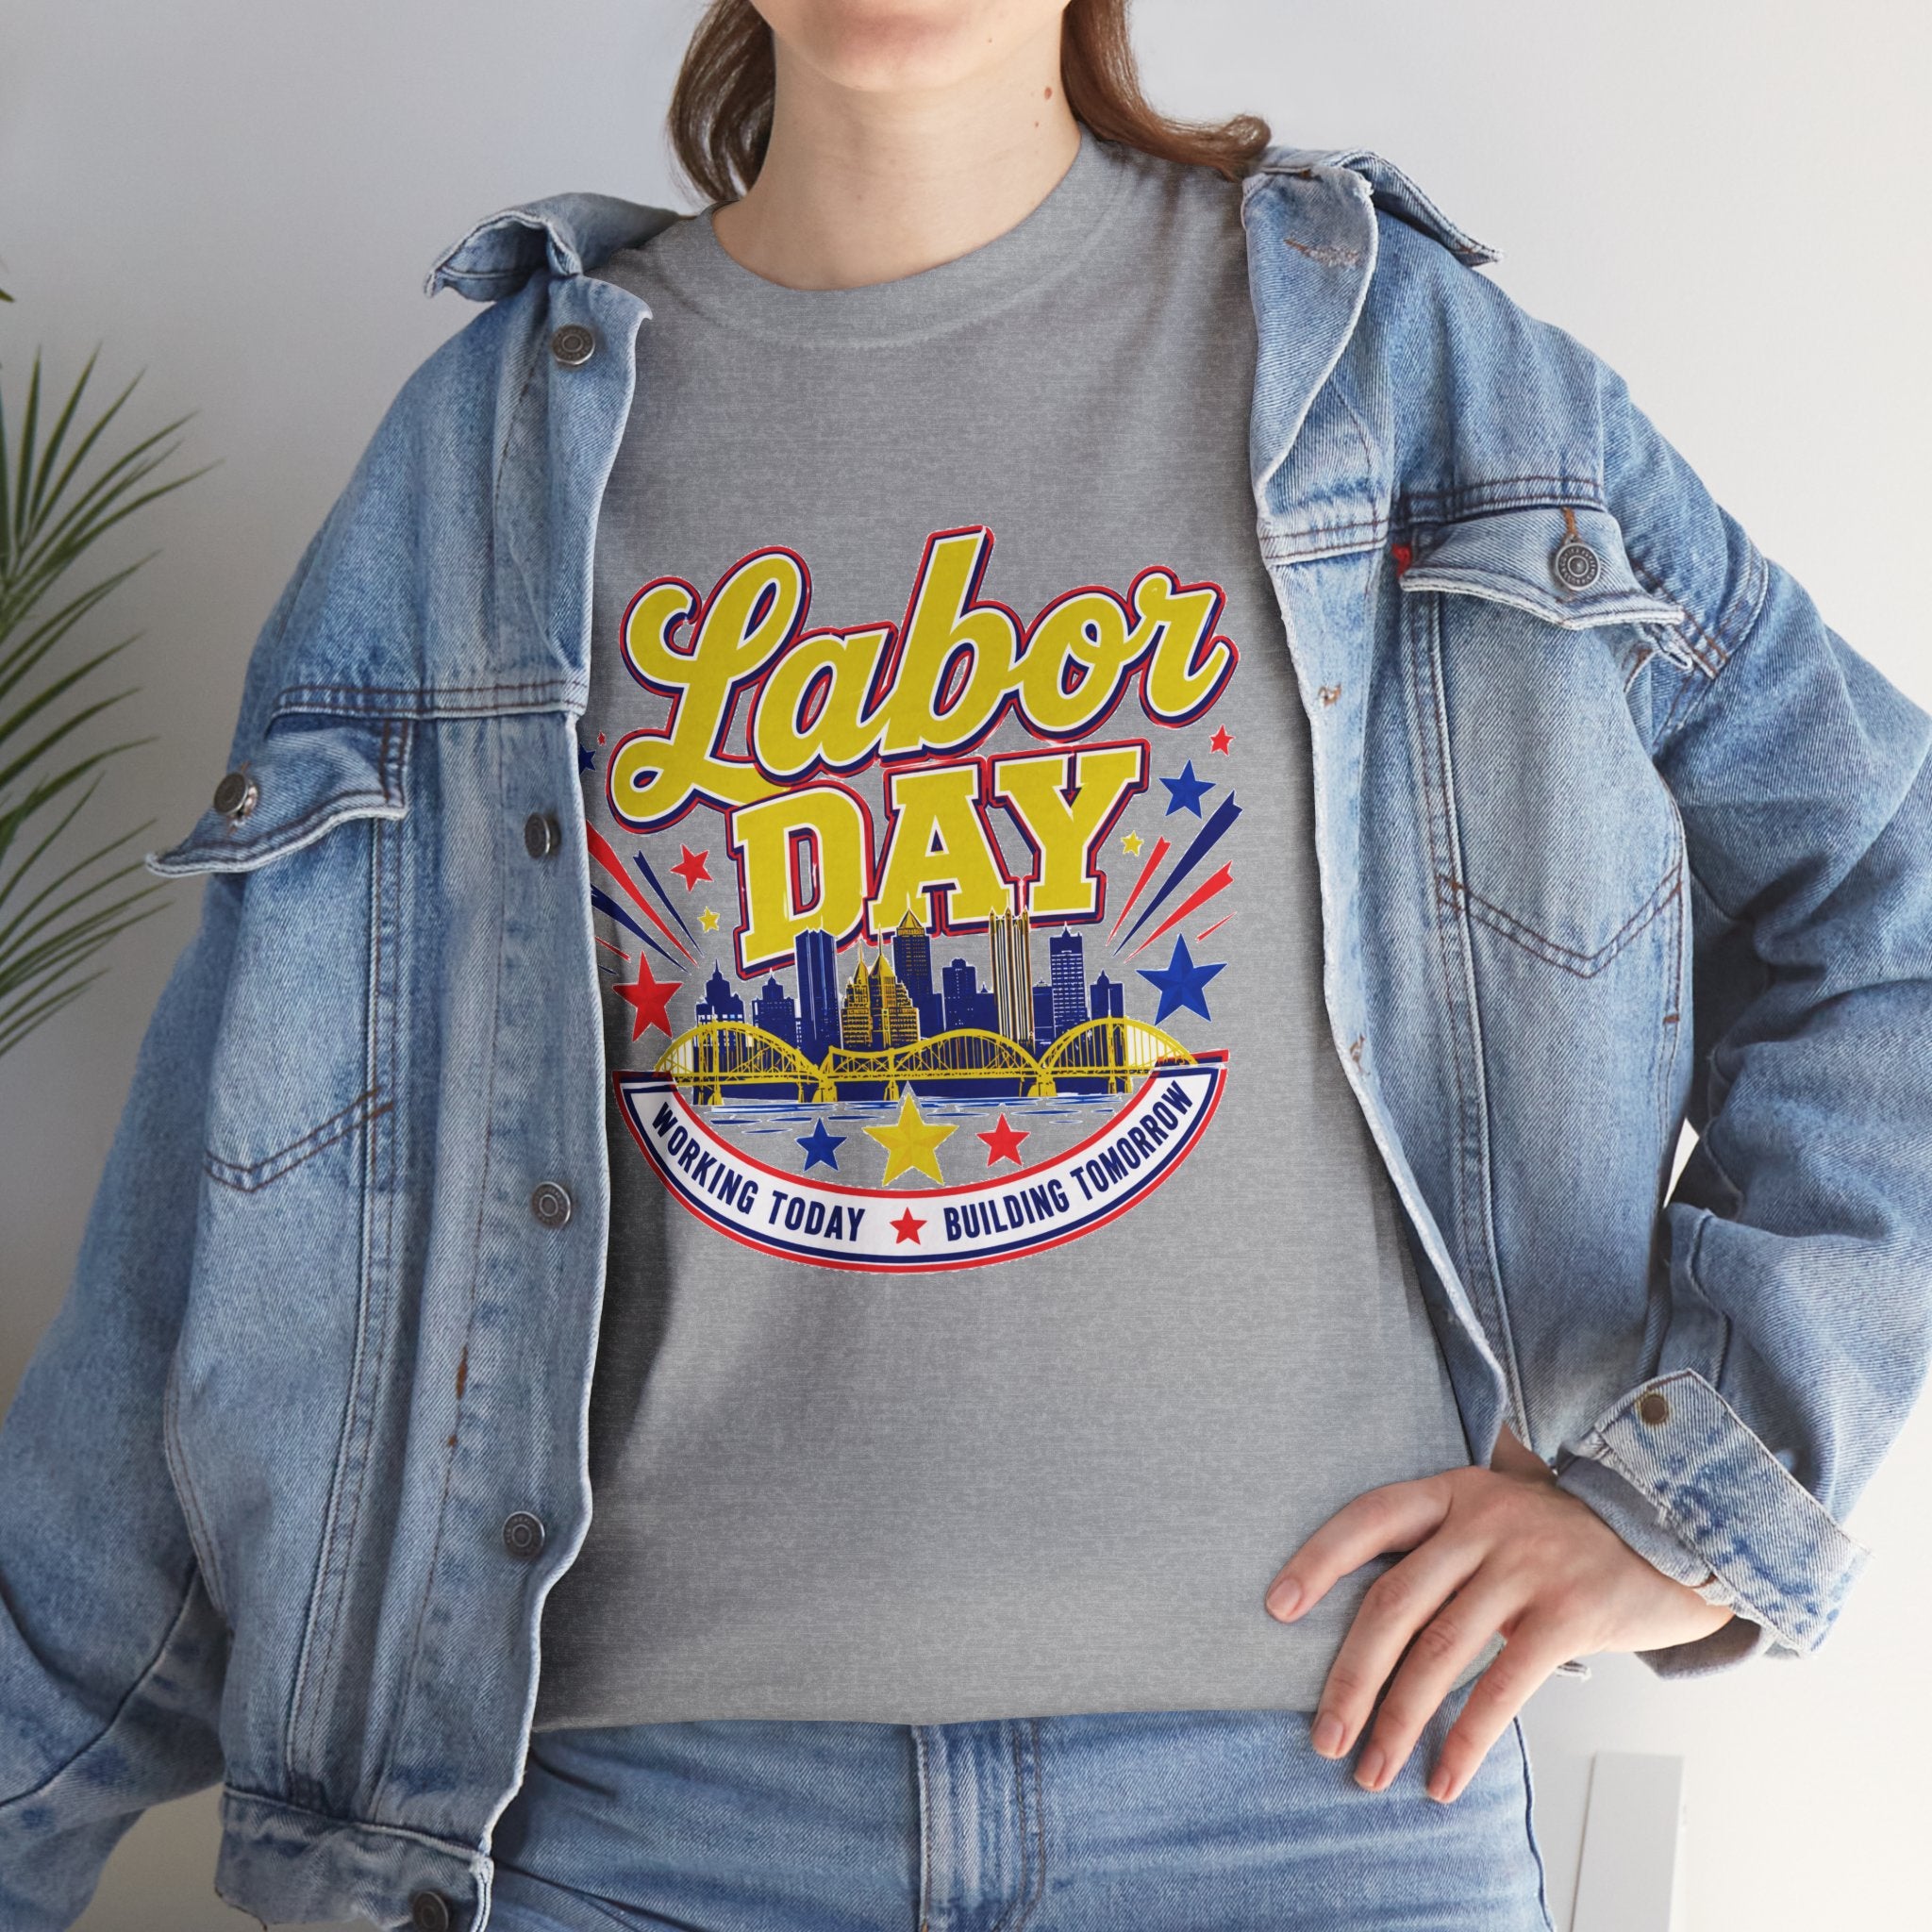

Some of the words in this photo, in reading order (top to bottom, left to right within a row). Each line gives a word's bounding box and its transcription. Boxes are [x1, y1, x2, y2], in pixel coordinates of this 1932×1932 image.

[608, 526, 1238, 833] Labor
[726, 740, 1149, 977] DAY
[652, 1100, 758, 1214] WORKING
[768, 1191, 866, 1242] TODAY
[944, 1179, 1070, 1242] BUILDING
[1070, 1080, 1193, 1201] TOMORROW
